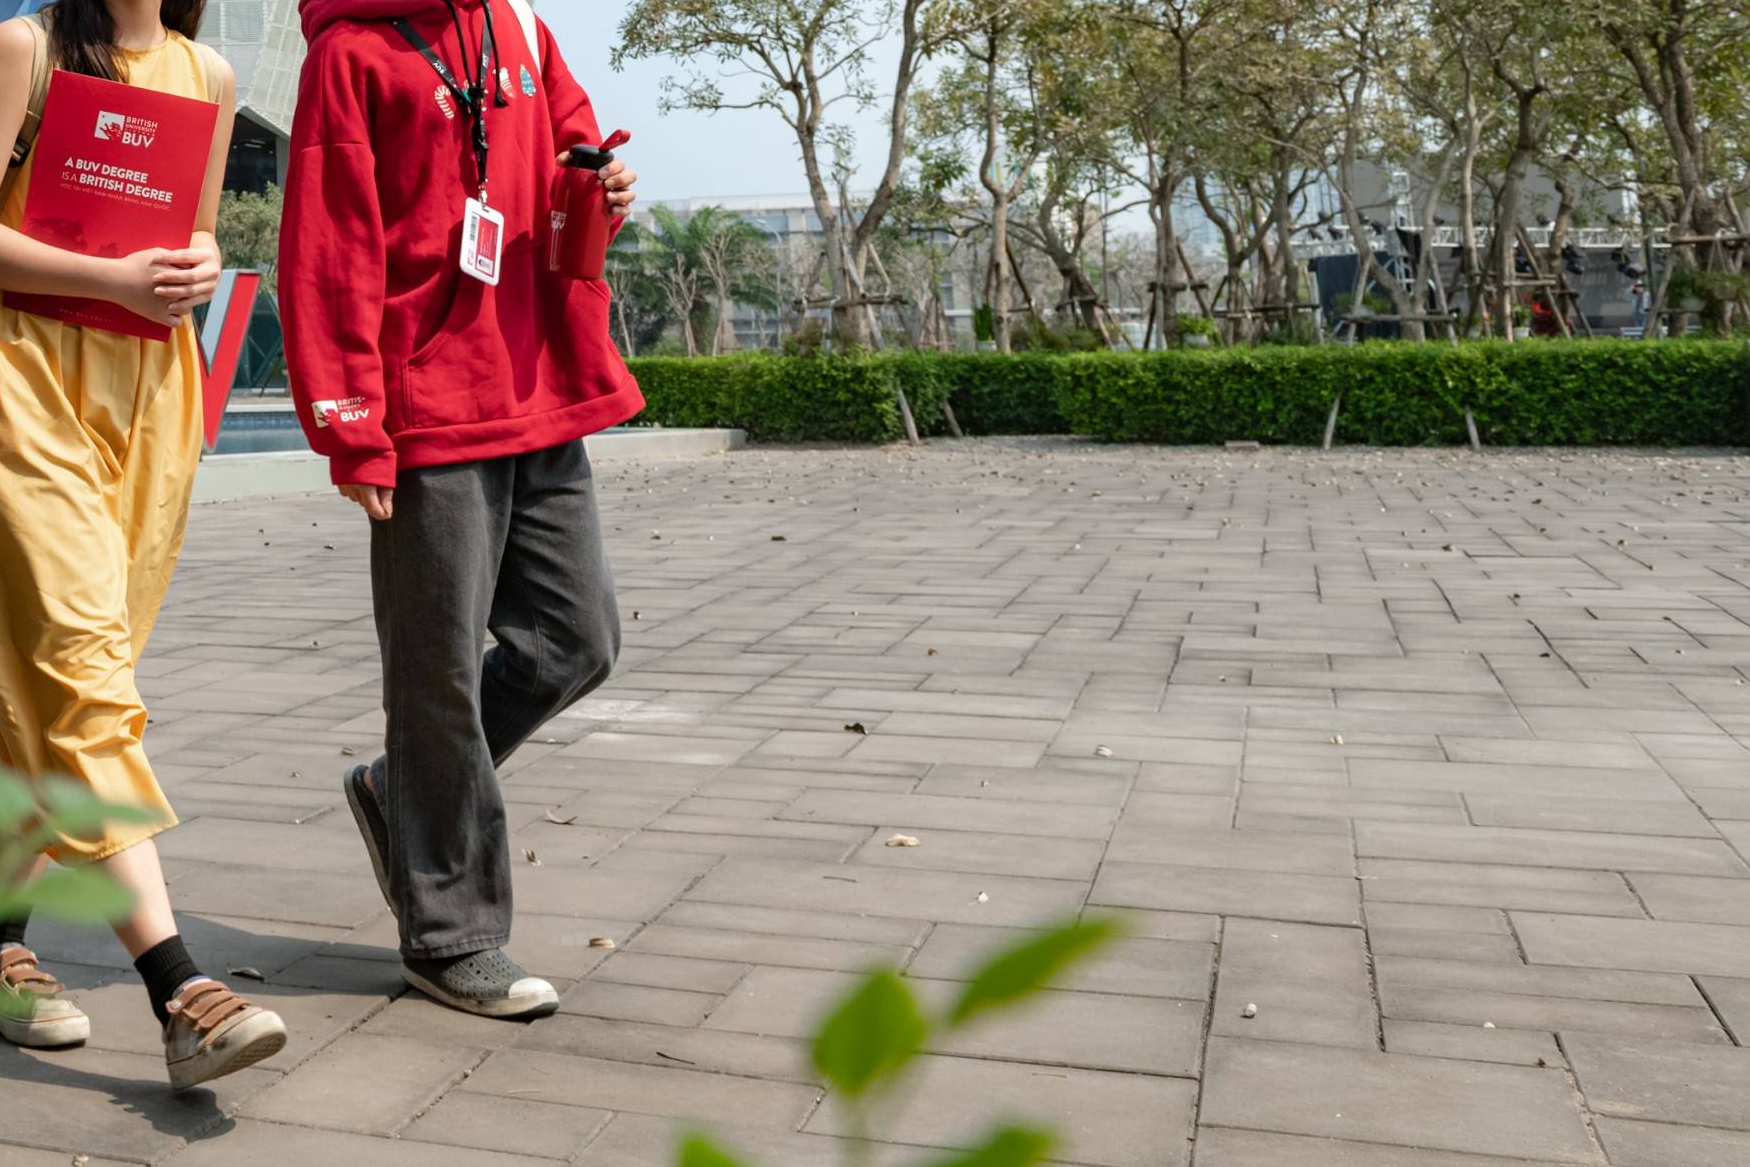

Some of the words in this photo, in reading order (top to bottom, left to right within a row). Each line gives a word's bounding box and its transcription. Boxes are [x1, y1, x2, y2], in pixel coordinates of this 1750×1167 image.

[126, 116, 158, 128] BRITISH
[122, 131, 154, 148] BUV
[64, 157, 74, 168] A
[75, 158, 101, 173] BUV
[101, 164, 148, 183] DEGREE
[61, 171, 70, 180] IS
[70, 173, 77, 182] A
[79, 173, 124, 192] BRITISH
[125, 183, 173, 203] DEGREE
[340, 408, 369, 422] BUV
